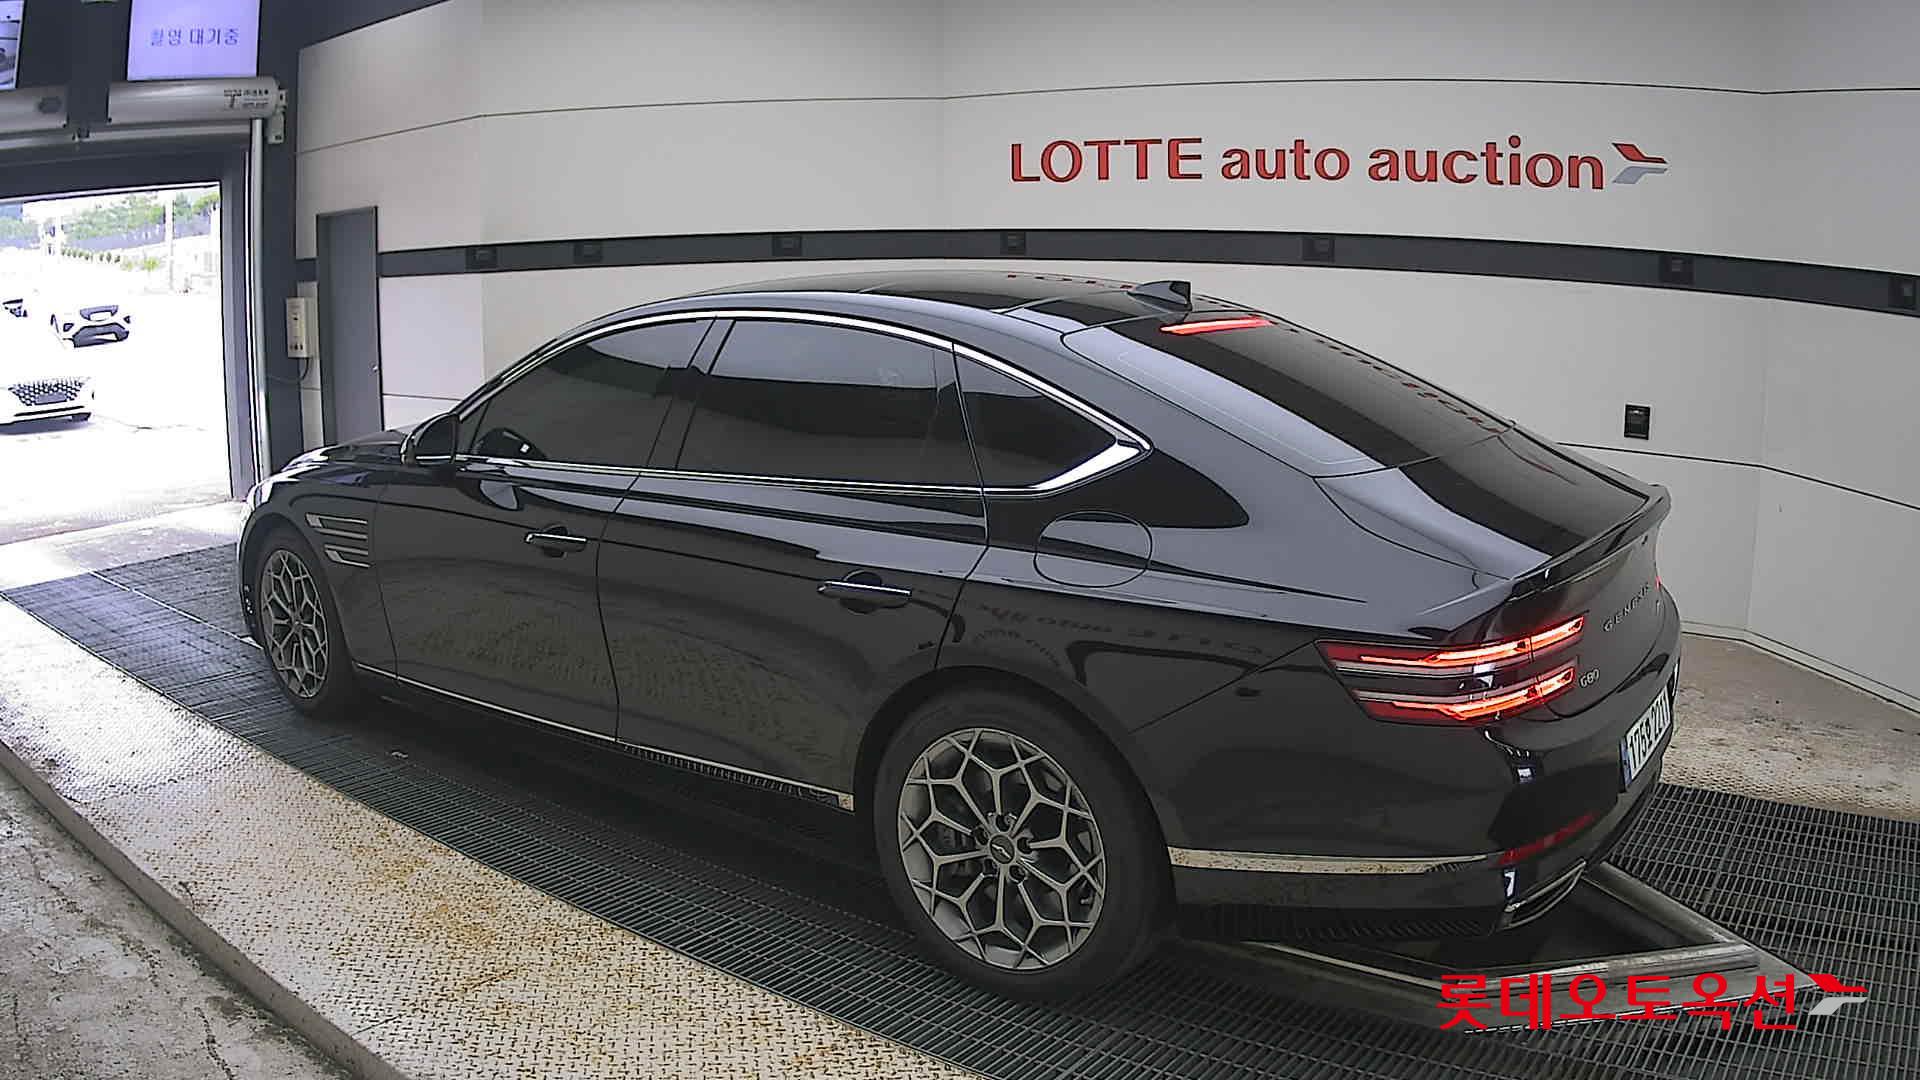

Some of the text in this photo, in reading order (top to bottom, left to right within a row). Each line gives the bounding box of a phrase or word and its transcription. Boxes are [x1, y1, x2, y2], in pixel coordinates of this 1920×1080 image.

[1011, 134, 1605, 190] LOTTE auto auction
[1579, 668, 1601, 689] G80
